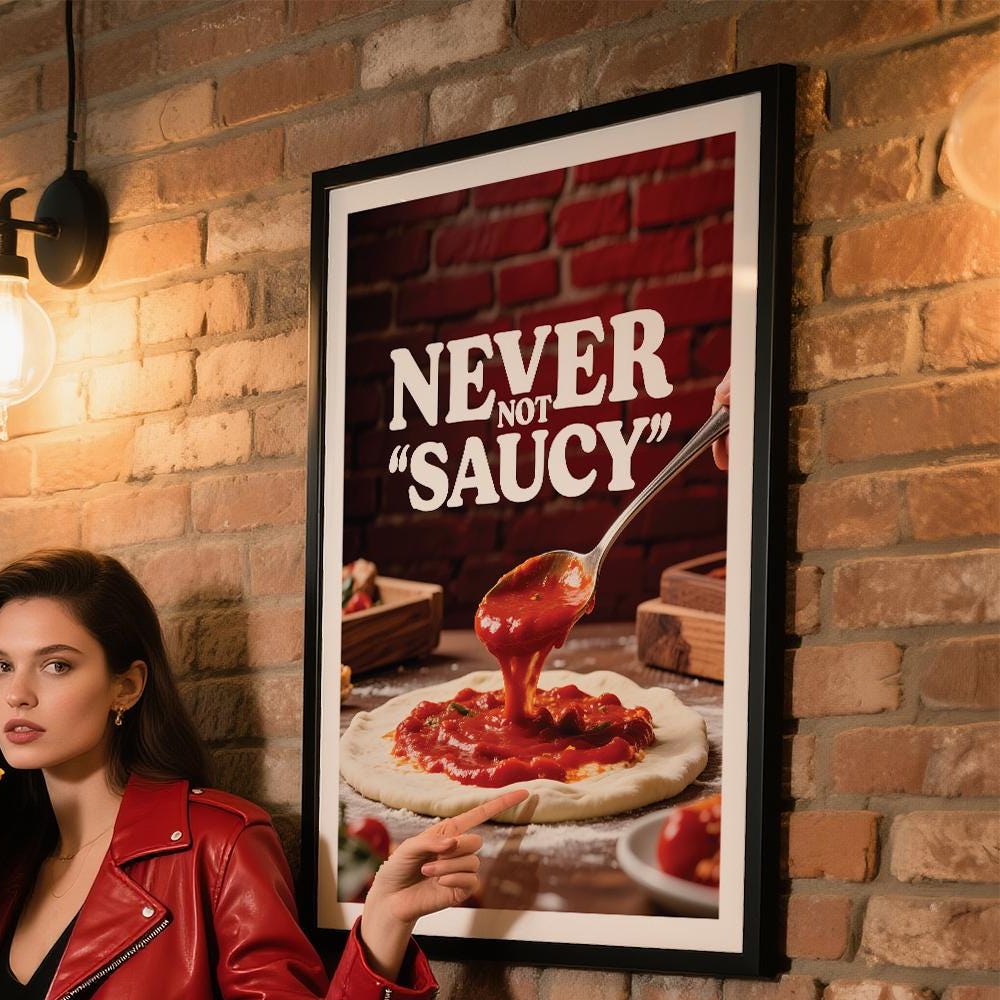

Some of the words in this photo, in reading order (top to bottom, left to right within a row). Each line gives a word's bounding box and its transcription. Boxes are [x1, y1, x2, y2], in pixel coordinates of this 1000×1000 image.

[389, 308, 674, 431] NEVER
[497, 394, 552, 429] NOT
[388, 411, 672, 512] “SAUCY”
